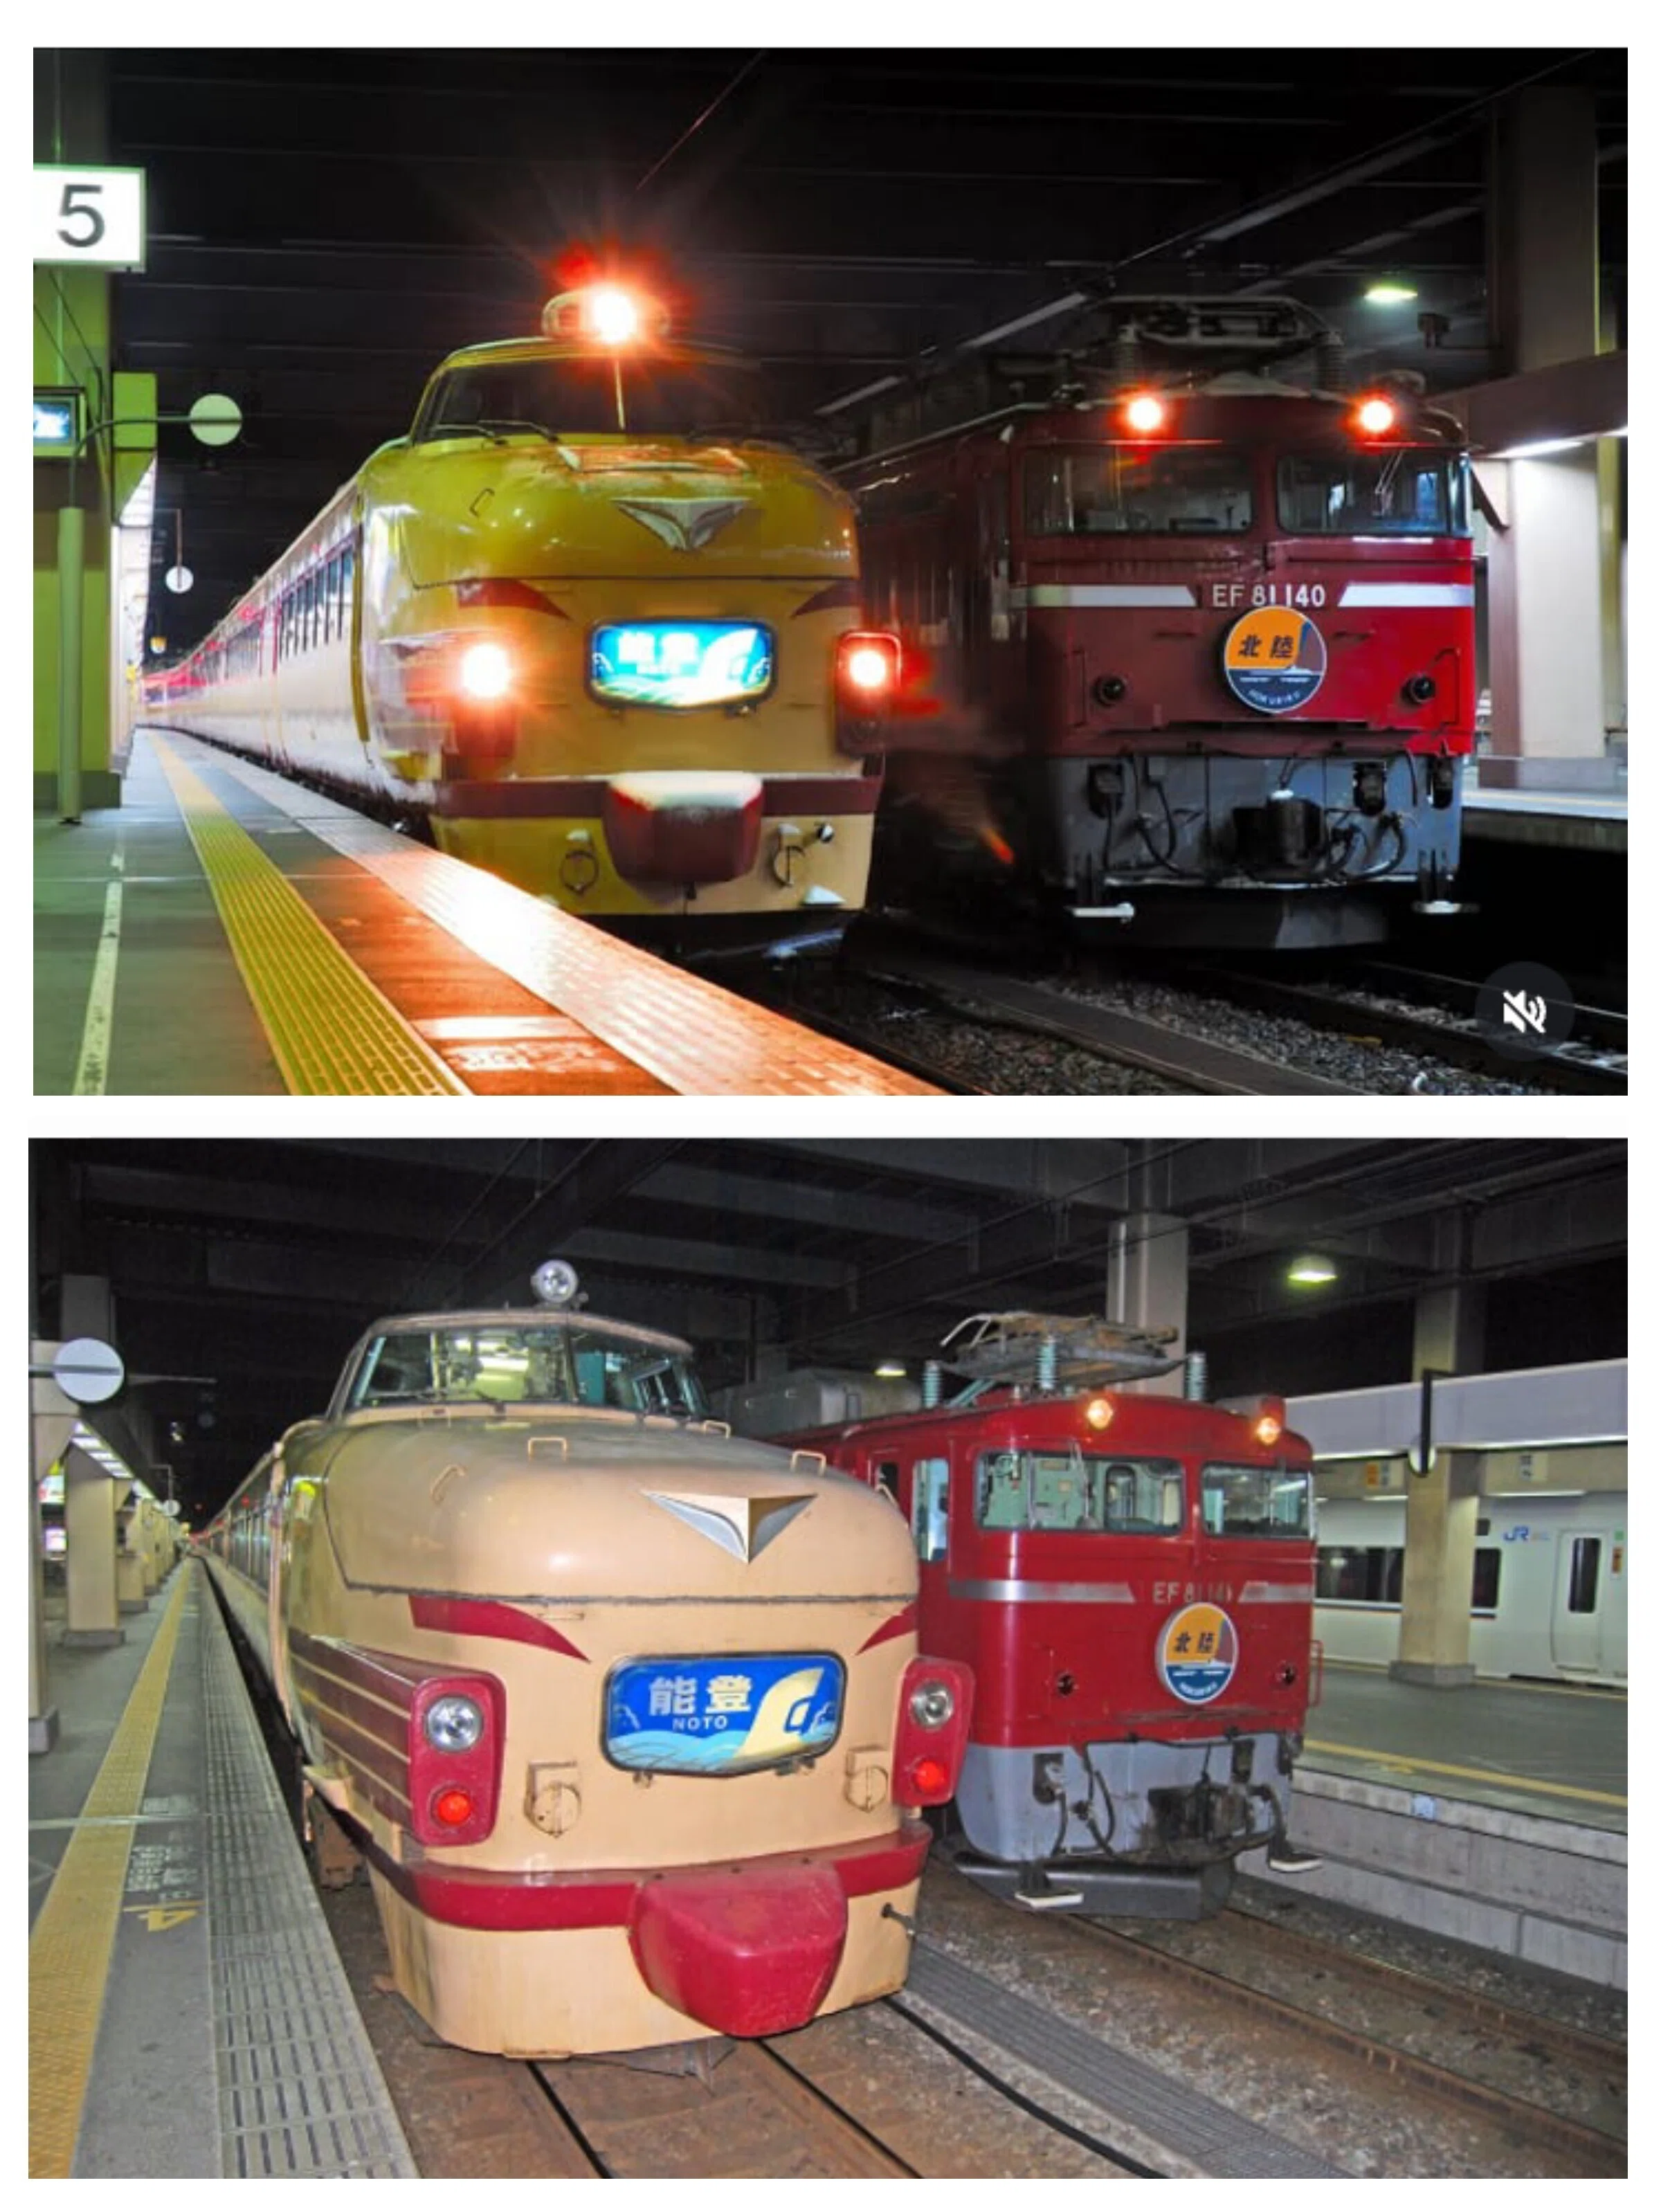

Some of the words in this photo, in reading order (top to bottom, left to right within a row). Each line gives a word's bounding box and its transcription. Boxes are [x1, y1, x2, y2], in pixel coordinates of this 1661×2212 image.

[57, 183, 105, 248] 5
[1213, 583, 1245, 608] EF
[1238, 633, 1294, 659] 北陸
[1501, 1525, 1530, 1542] JR
[648, 1674, 752, 1716] 能登
[672, 1714, 729, 1731] NOTO
